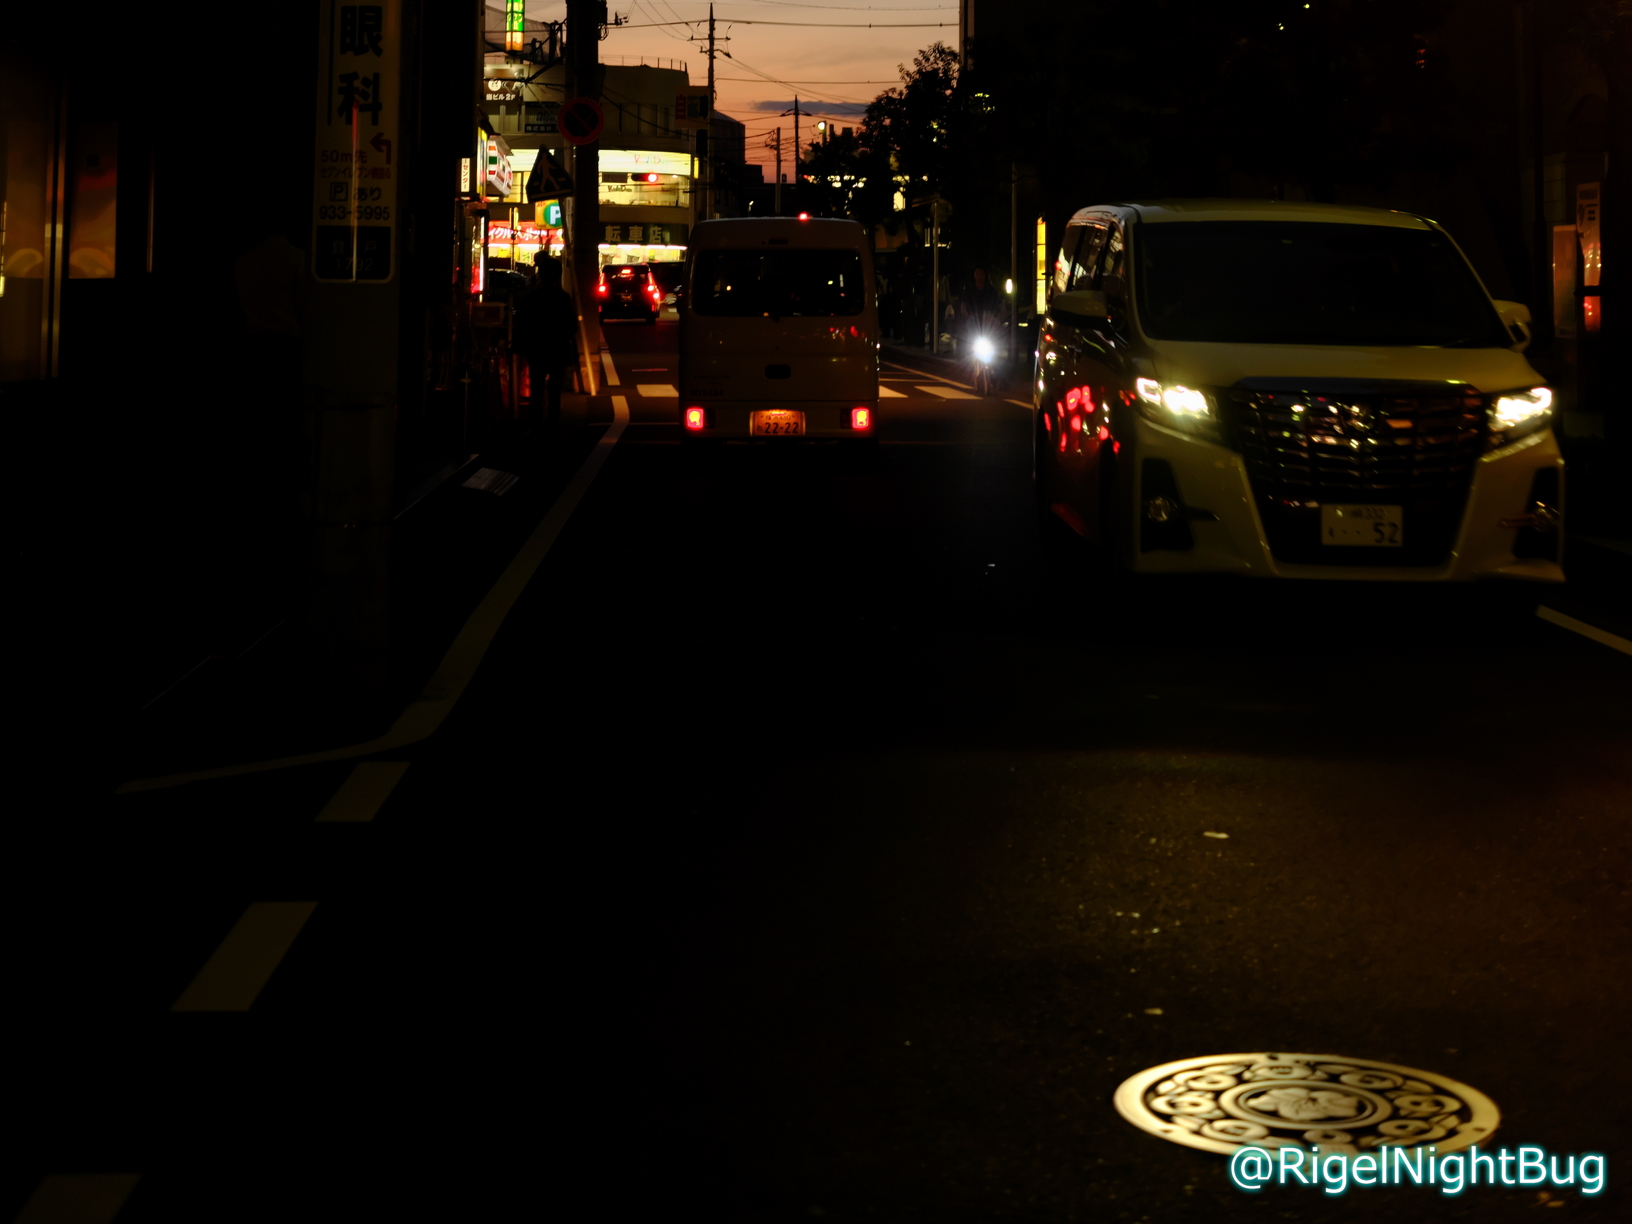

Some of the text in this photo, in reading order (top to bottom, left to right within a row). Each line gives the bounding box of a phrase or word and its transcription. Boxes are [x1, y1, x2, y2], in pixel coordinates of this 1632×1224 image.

[319, 205, 390, 220] 933-5995
[550, 206, 561, 225] P
[765, 422, 799, 434] 22-22
